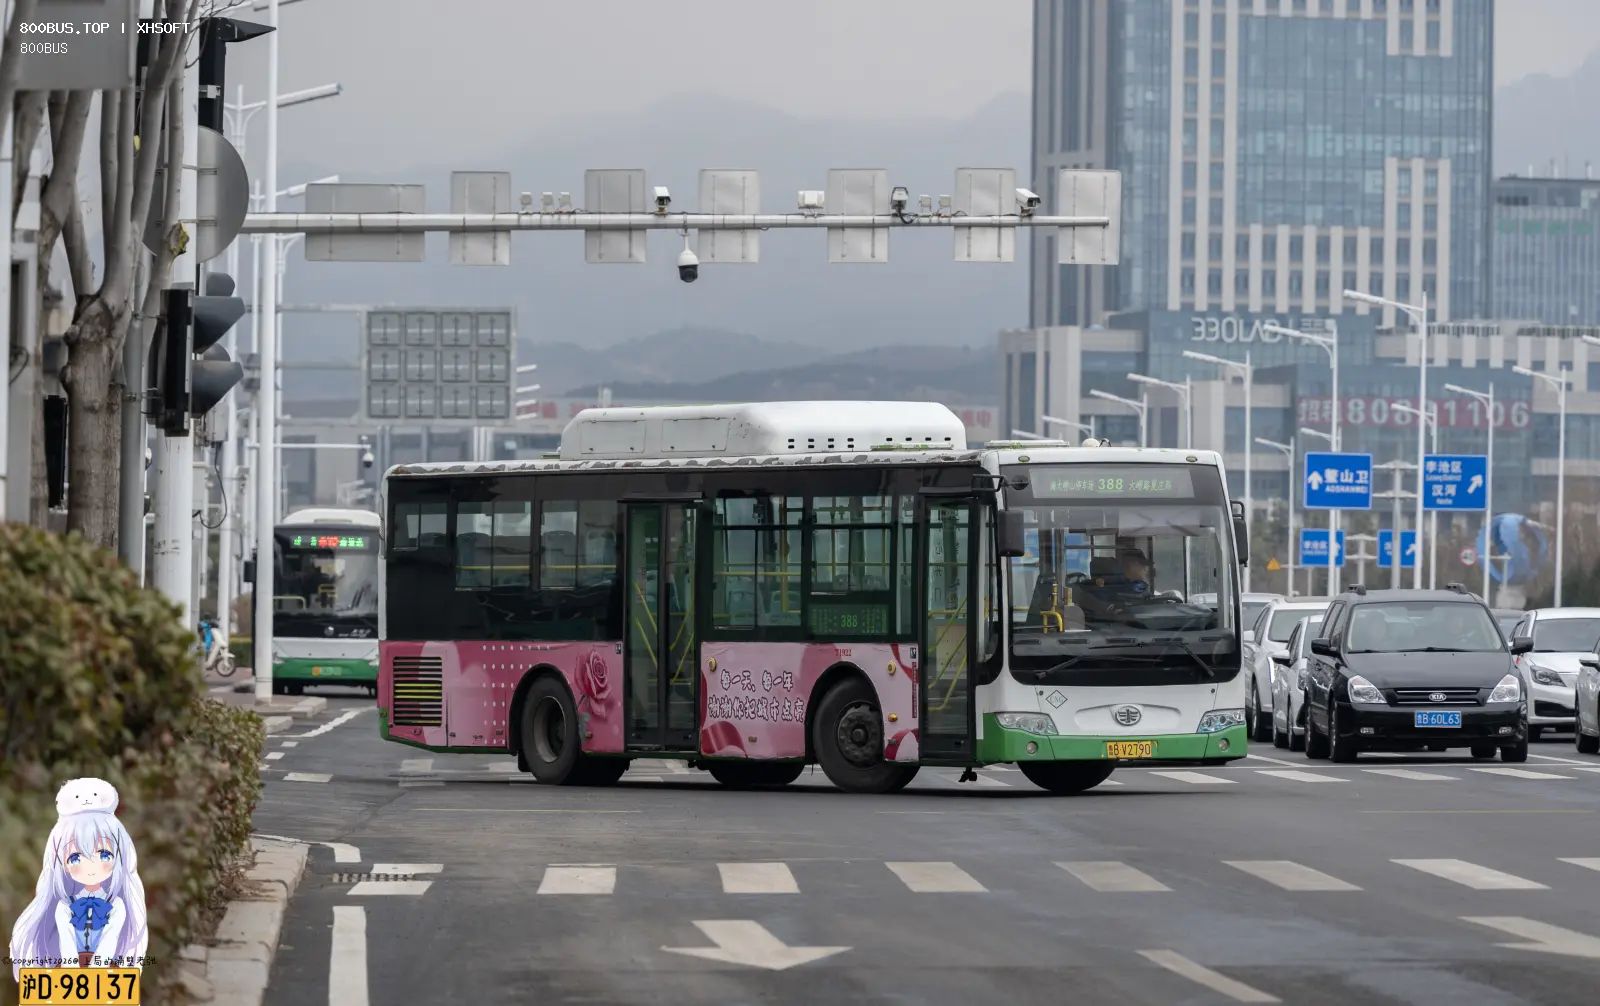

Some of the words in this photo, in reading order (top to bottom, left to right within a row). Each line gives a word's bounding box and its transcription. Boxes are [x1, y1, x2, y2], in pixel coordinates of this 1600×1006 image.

[1098, 478, 1123, 490] 388
[841, 614, 858, 628] 388
[1049, 696, 1064, 704] CNG
[708, 695, 804, 723] 谢谢你把城市点亮
